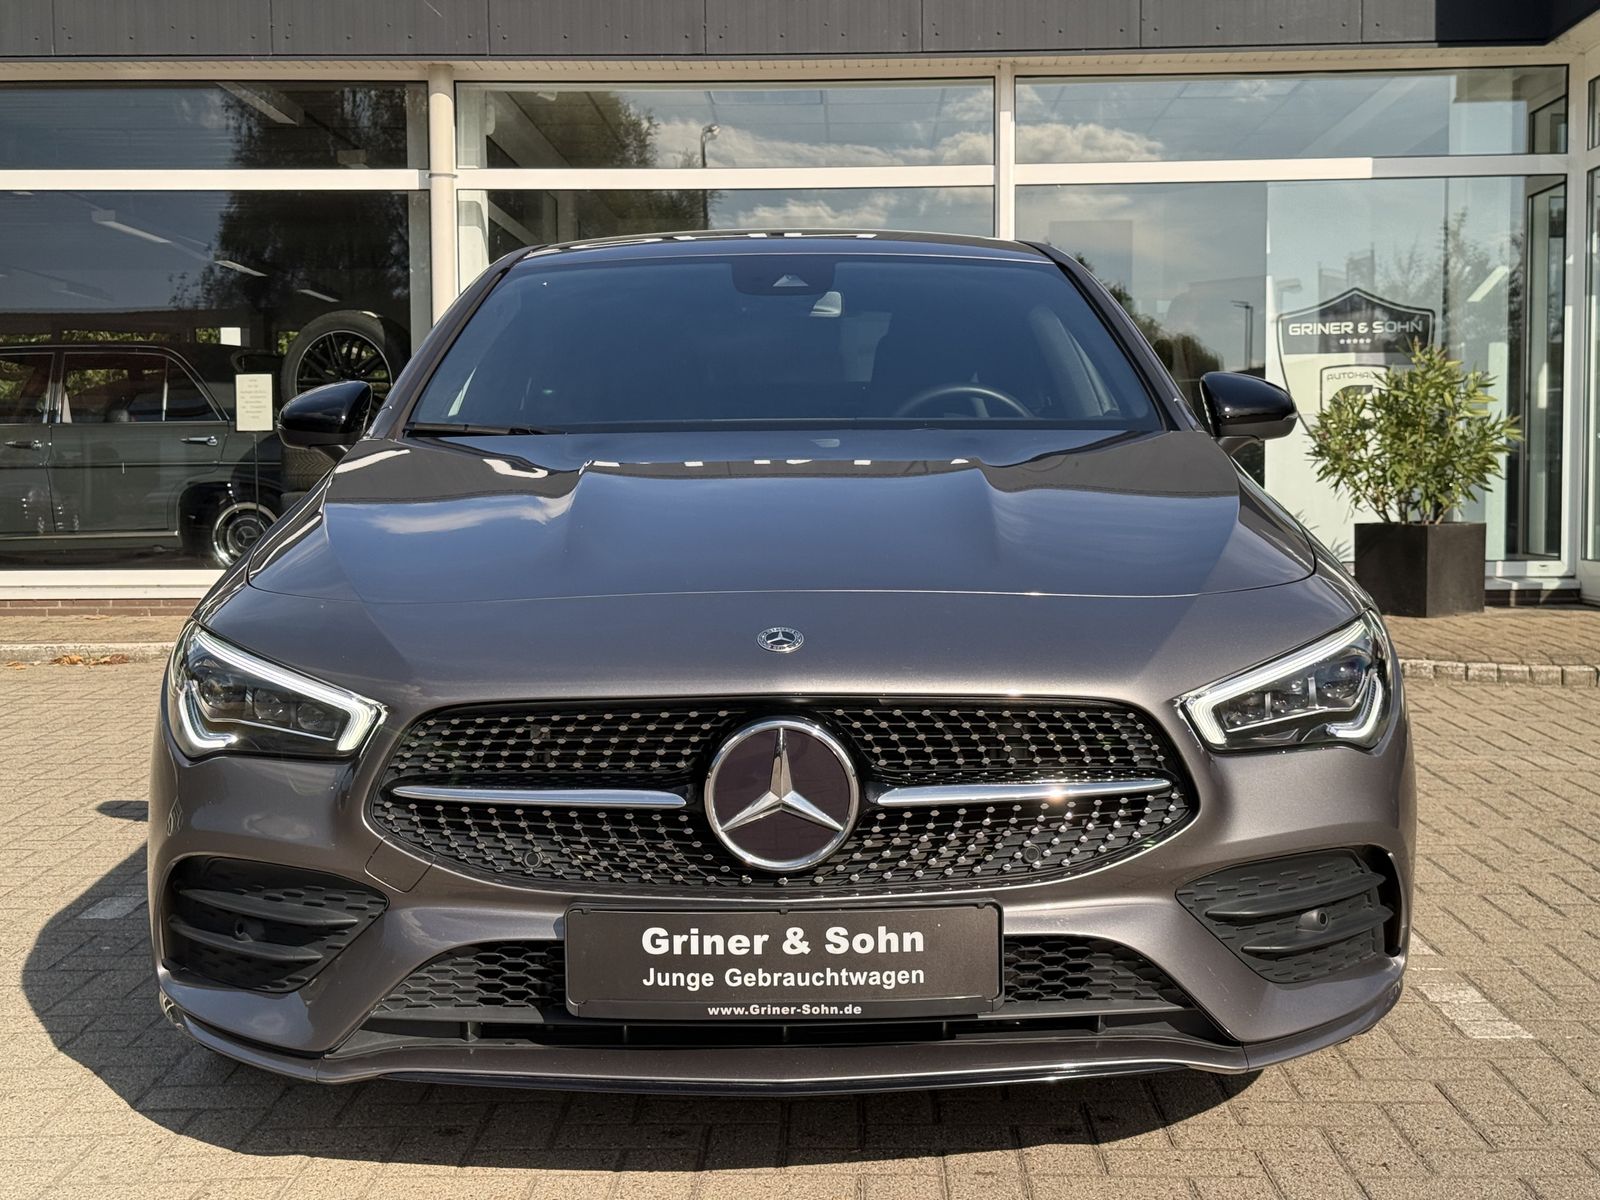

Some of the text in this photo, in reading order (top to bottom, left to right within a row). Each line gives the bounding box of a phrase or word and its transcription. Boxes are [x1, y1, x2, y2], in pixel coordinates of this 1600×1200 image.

[1288, 320, 1423, 335] GRINER & SOHN
[641, 926, 924, 956] Griner & Sohn
[642, 966, 925, 992] Junge Gebrauchtwagen
[707, 1003, 862, 1016] www.Griner-Sohn.de
